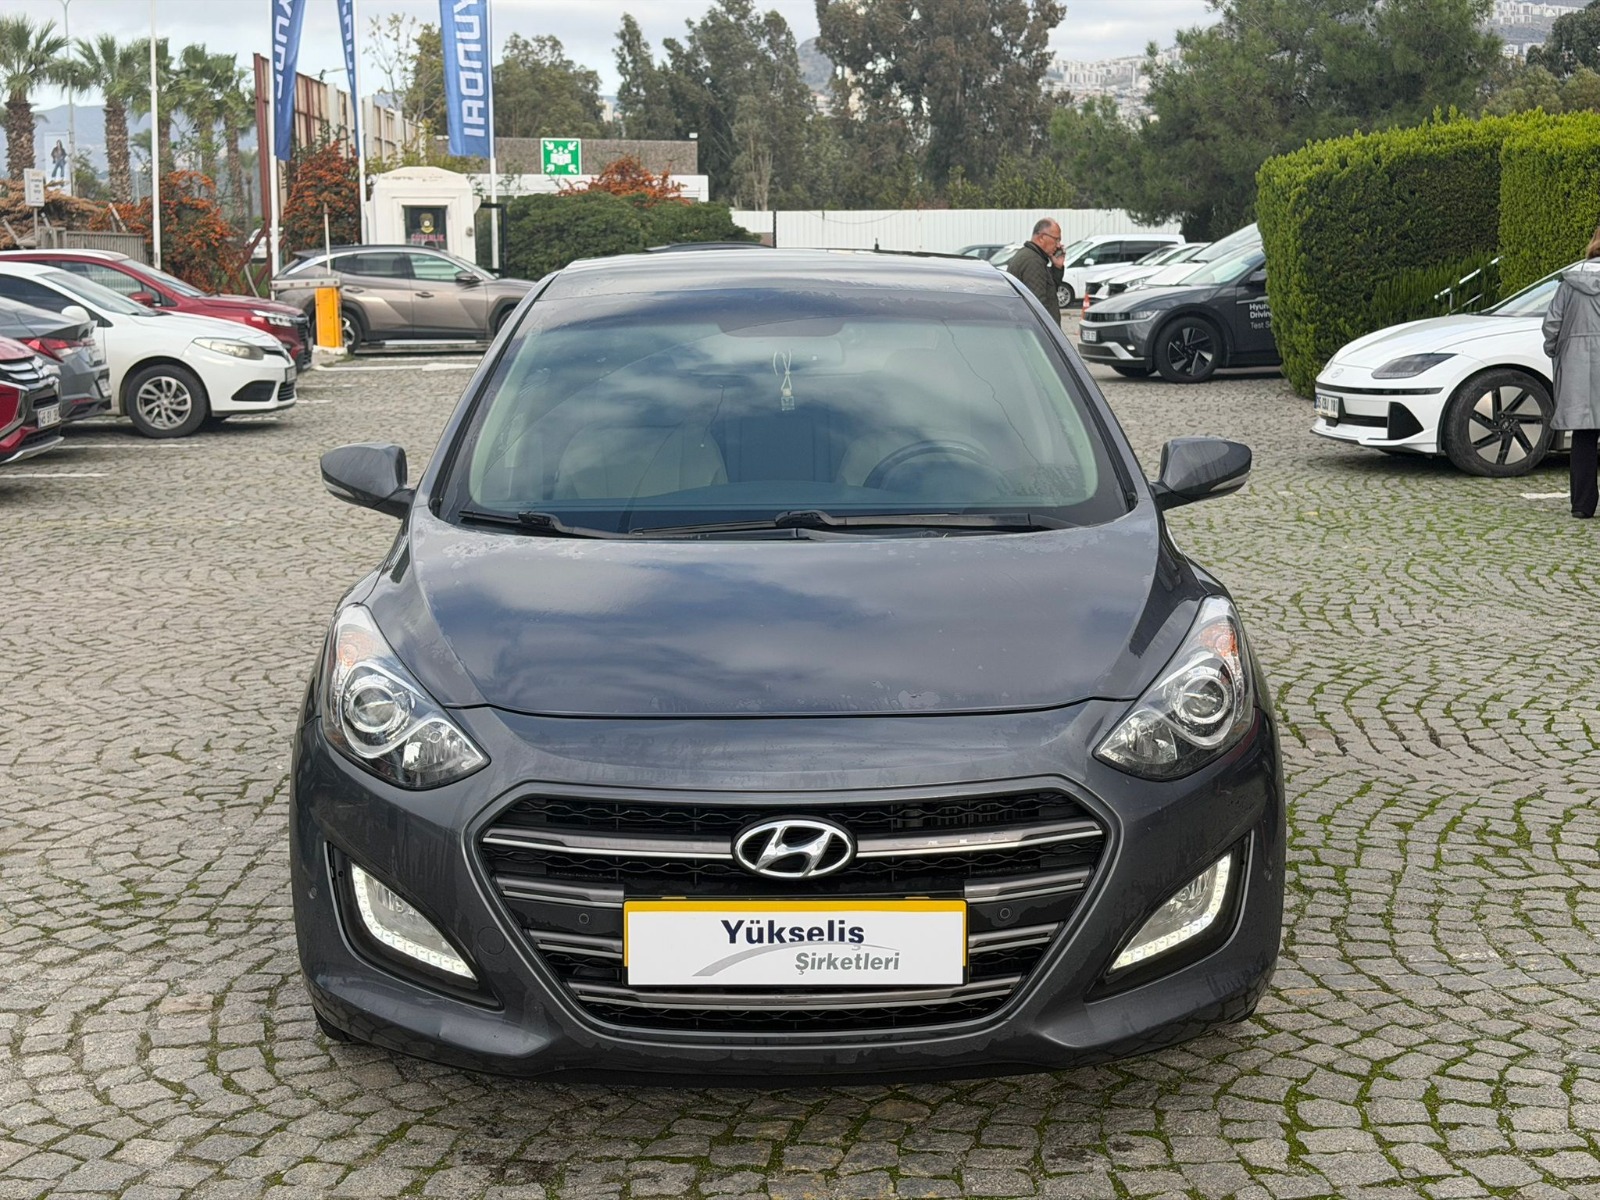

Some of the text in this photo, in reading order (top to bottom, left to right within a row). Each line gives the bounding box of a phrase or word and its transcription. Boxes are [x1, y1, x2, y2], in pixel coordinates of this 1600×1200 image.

[1250, 321, 1264, 329] Test
[720, 919, 865, 950] Yükseliş
[795, 951, 901, 975] Şirketleri
